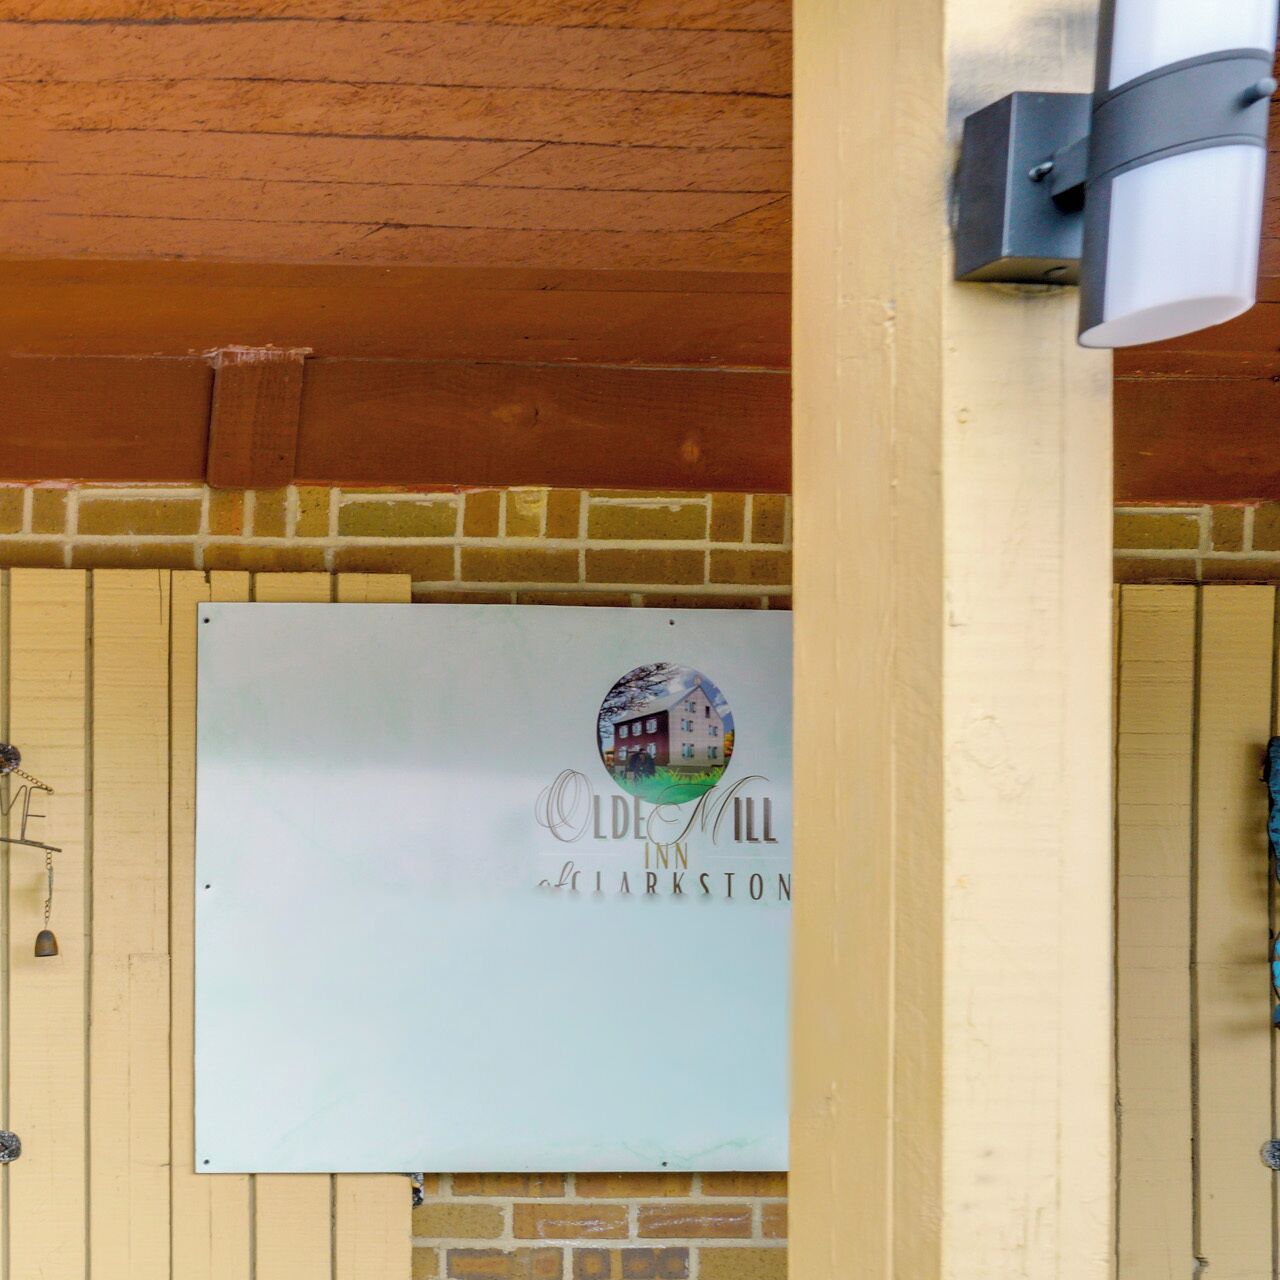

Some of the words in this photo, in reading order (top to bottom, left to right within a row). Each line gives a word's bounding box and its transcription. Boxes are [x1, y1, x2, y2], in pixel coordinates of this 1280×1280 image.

[535, 768, 647, 842] OLDE
[647, 775, 779, 846] MILL
[644, 843, 689, 870] INN
[571, 870, 792, 901] CLARKSTON
